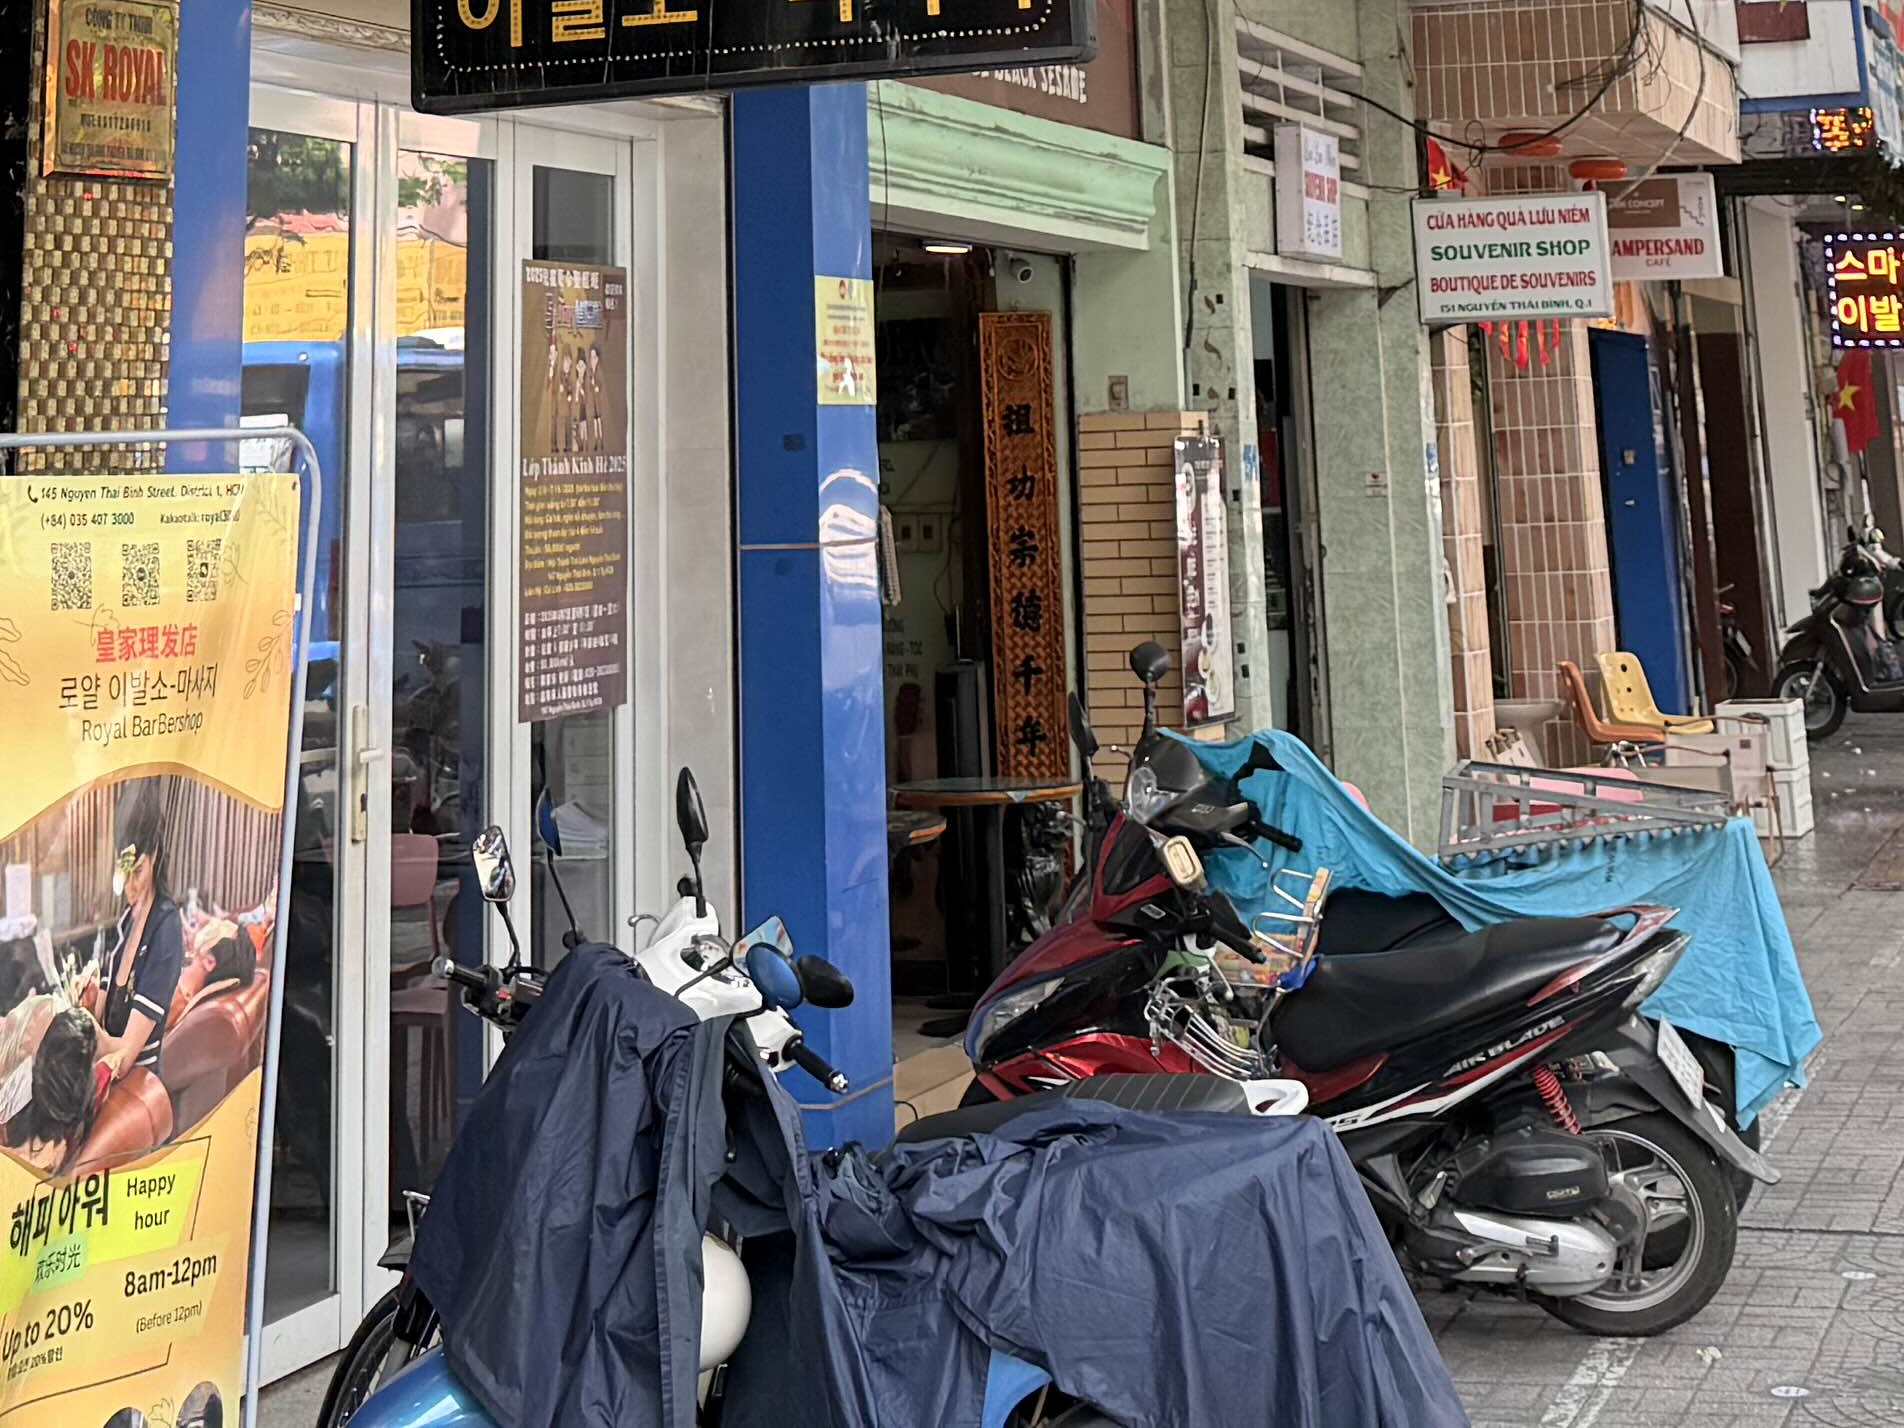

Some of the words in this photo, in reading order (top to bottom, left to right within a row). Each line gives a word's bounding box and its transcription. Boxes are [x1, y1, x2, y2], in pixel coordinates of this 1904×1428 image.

[65, 39, 96, 100] SK
[102, 43, 168, 106] ROYAL
[1430, 242, 1532, 262] SOUVENIR
[1536, 238, 1592, 258] SHOP
[1611, 237, 1705, 258] AMPERSAND
[1430, 273, 1499, 295] BOUTIQUE
[1499, 273, 1520, 291] DE
[1520, 270, 1596, 290] SOUVENIRS
[69, 513, 88, 527] 035
[95, 622, 199, 664] 皇家理发店
[58, 673, 102, 711] 로얄
[82, 717, 129, 747] Royal
[131, 709, 203, 740] BarBershop
[1442, 1050, 1486, 1078] AIR
[1487, 1015, 1566, 1058] BLADE
[125, 1172, 177, 1199] Happy
[133, 1208, 171, 1232] hour
[123, 1254, 218, 1298] 8am-12pm
[43, 1298, 95, 1342] 20%
